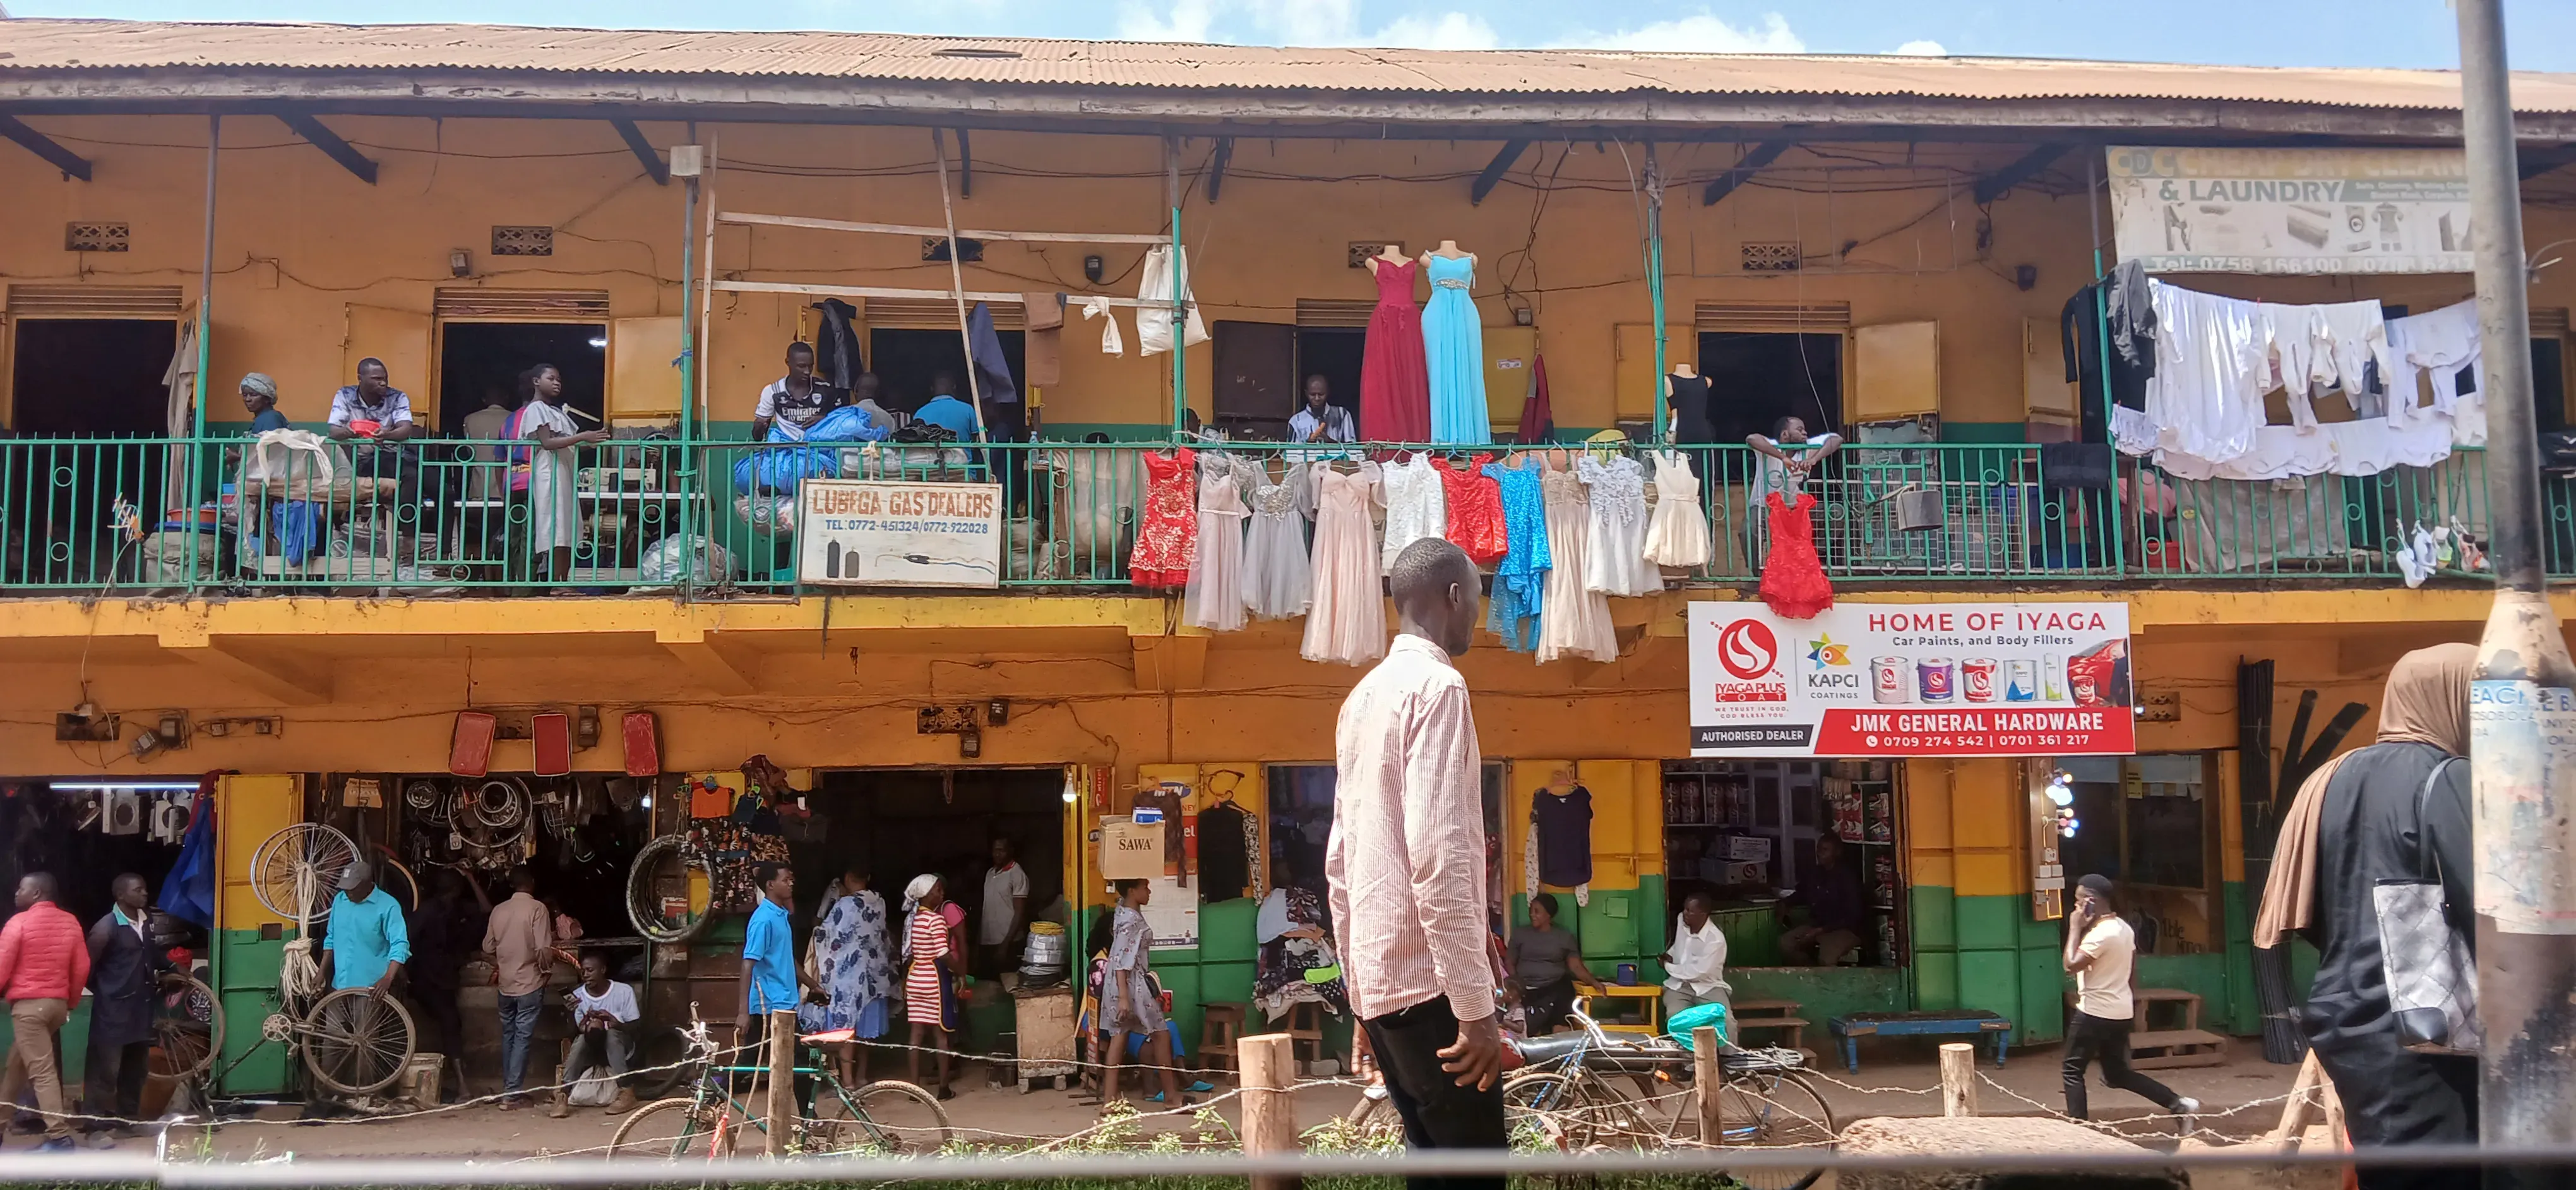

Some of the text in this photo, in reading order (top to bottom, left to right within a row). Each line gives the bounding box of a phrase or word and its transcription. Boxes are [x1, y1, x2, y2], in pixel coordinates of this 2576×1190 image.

[2364, 150, 2466, 176] CLEAN
[2159, 180, 2179, 201] &
[2189, 180, 2341, 202] LAUNDRY
[2151, 256, 2193, 270] Tel:
[2200, 256, 2253, 271] 0758
[813, 489, 993, 519] LUBEGA GAS DEALERS
[1869, 611, 2106, 632] HOME OF IYAGA
[1892, 634, 2074, 647] Car Paints, and Body Fillers
[1715, 682, 1786, 693] IYAGA PLUS
[1808, 673, 1859, 688] KAPCI
[1717, 693, 1784, 702] COAT
[1850, 712, 2104, 733] JMK GENERAL HARDWARE
[1701, 730, 1804, 742] AUTHORISED DEALER
[1883, 736, 1920, 747] 0709
[1924, 735, 1952, 747] 274
[1957, 735, 1984, 747] 542
[1999, 734, 2033, 746] 0701
[2037, 734, 2061, 746] 361
[2066, 733, 2090, 745] 217
[1184, 825, 1196, 838] el
[1119, 838, 1152, 851] SAWA
